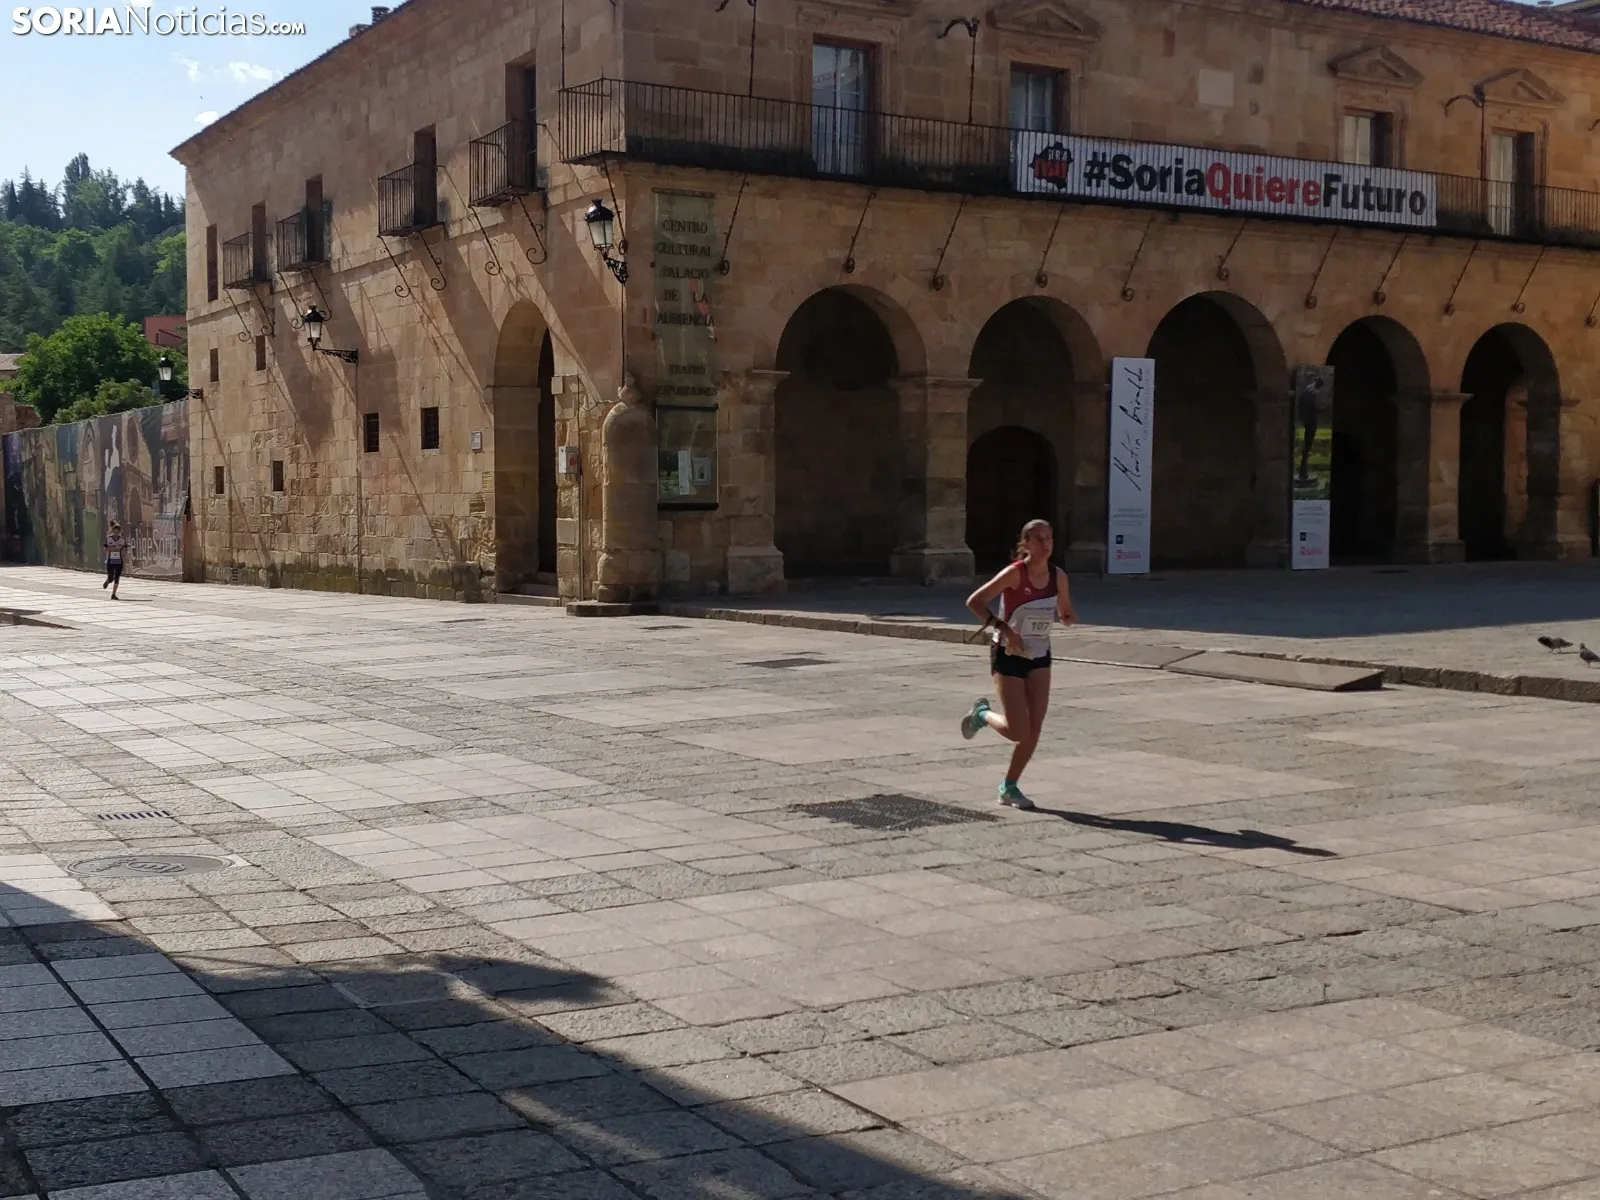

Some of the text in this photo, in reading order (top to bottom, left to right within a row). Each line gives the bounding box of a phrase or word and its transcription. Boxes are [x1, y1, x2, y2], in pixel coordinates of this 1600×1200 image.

[1083, 150, 1428, 217] #SoriaQuiereFuturo
[662, 219, 708, 235] CENTRO
[656, 241, 713, 257] CULTURAL
[661, 265, 710, 280] PALACIO
[664, 288, 708, 304] DE LA
[657, 311, 715, 327] AUDIENCIA
[1031, 621, 1050, 632] 107
